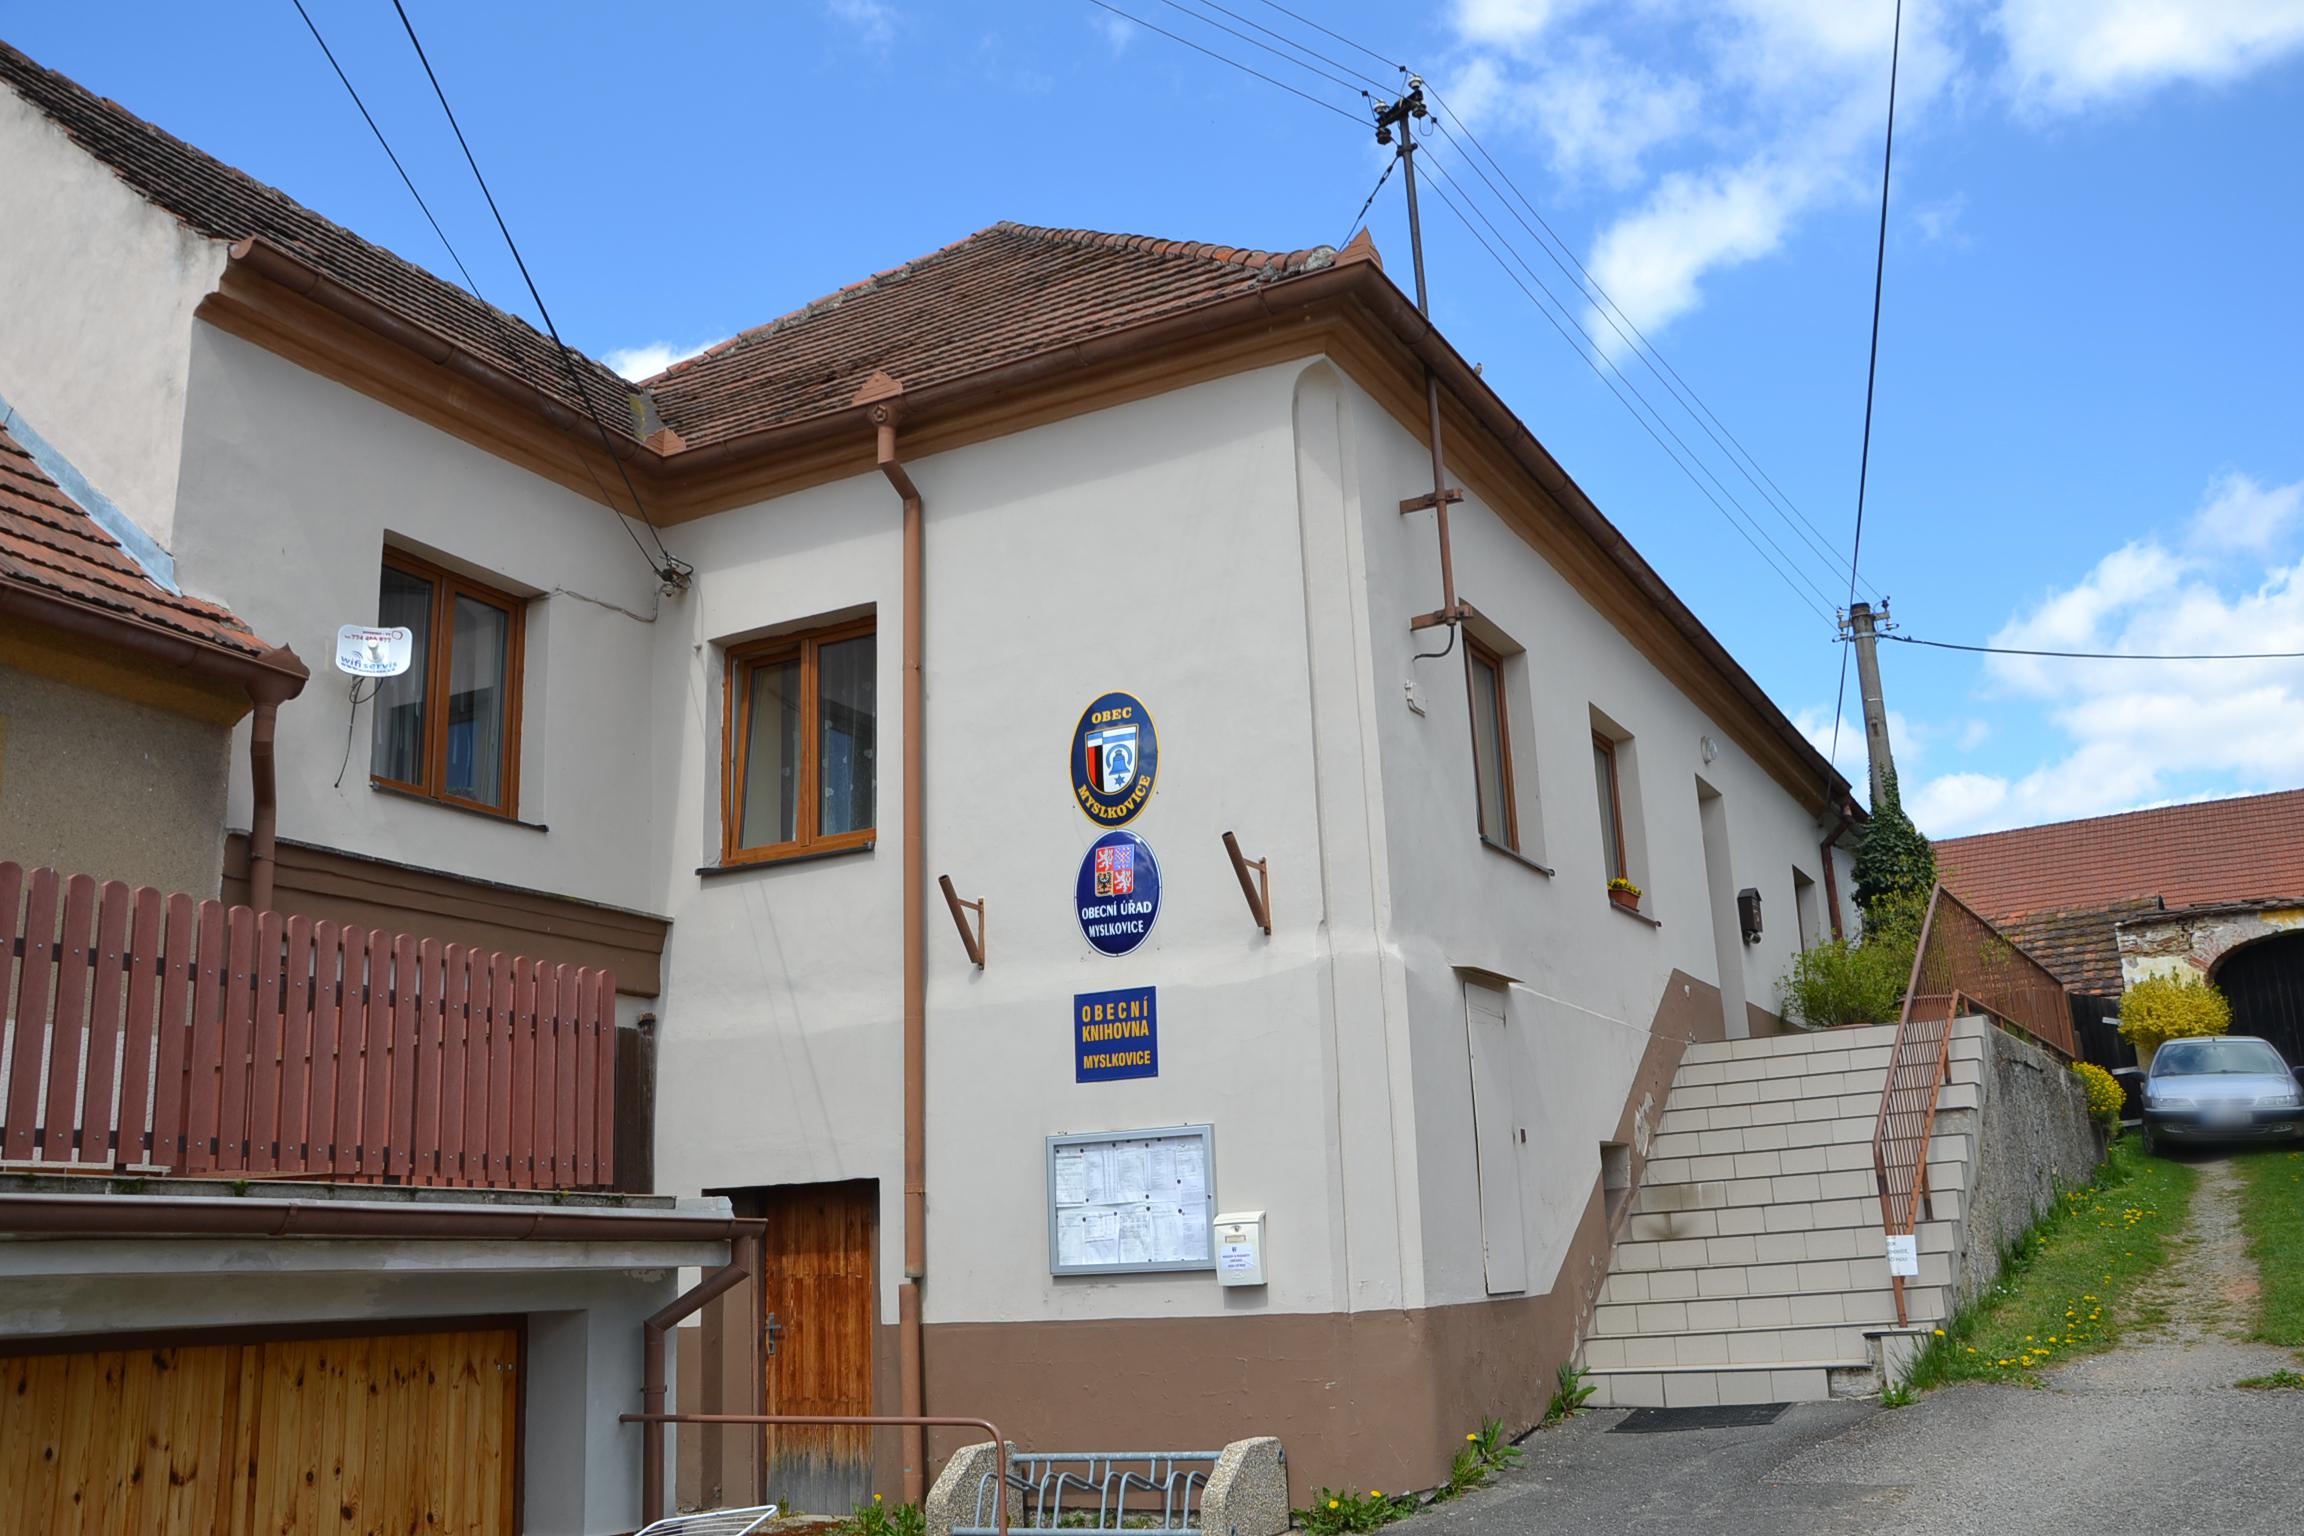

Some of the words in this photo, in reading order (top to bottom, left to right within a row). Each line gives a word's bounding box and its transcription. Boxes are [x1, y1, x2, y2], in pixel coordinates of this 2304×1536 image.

[341, 655, 362, 668] wifi
[363, 661, 398, 670] servis
[1091, 706, 1133, 724] OBEC
[1078, 775, 1151, 819] MYSLKOVICE
[1081, 901, 1118, 920] OBECNÍ
[1120, 899, 1153, 915] ÚŘAD
[1088, 919, 1145, 938] MYSLKOVICE
[1081, 995, 1149, 1023] OBECNÍ
[1082, 1019, 1150, 1043] KNIHOVNA
[1083, 1050, 1151, 1069] MYSLKOVICE
